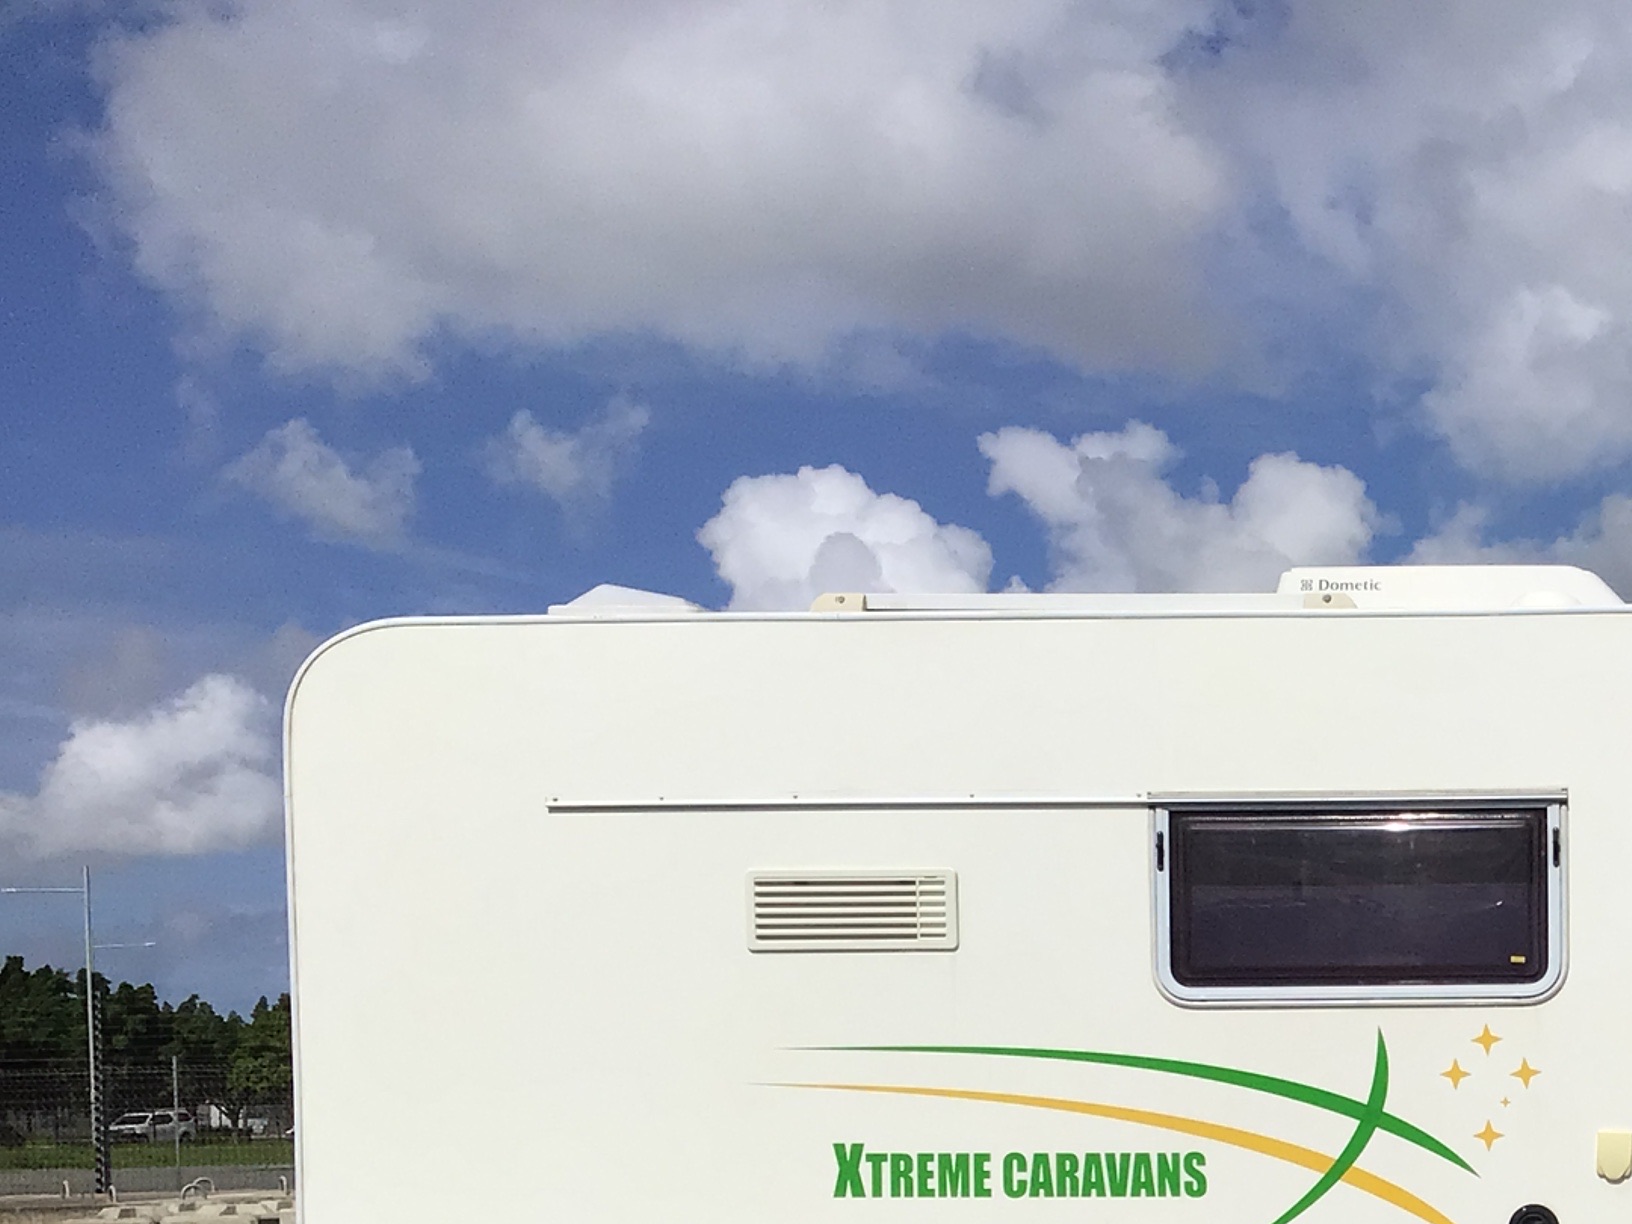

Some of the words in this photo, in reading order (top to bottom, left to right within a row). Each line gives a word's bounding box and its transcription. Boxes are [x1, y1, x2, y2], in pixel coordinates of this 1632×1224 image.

[1317, 578, 1382, 592] Dometic
[832, 1142, 993, 1199] XTREME
[1002, 1151, 1208, 1199] CARAVANS
